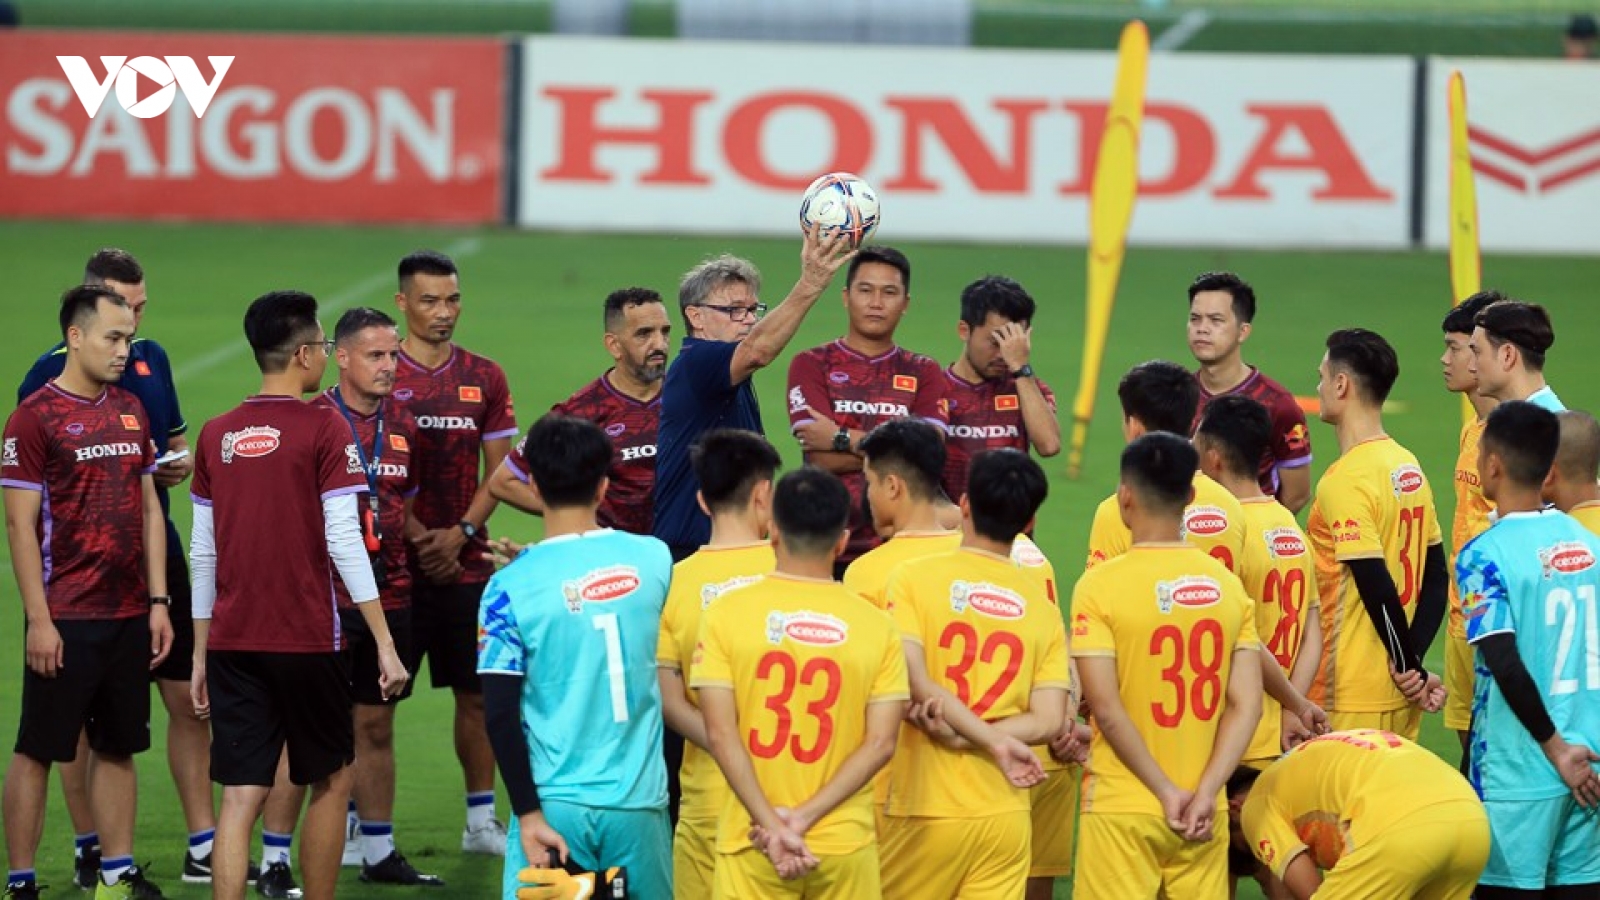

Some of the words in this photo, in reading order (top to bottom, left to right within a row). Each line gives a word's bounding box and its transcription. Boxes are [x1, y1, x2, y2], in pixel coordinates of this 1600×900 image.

[540, 84, 1396, 203] HONDA
[416, 414, 478, 430] ONDA
[834, 399, 909, 416] HONDA
[75, 443, 142, 462] HONDA
[236, 439, 275, 451] ACECOOK
[1398, 507, 1424, 606] 37
[585, 578, 636, 597] ACECOOK
[971, 594, 1022, 615] ACECOOK
[1175, 589, 1219, 601] ACECOOK
[788, 624, 841, 641] ACECOOK
[1262, 568, 1306, 669] 28
[1545, 585, 1600, 696] 21
[592, 613, 629, 722] 1
[938, 620, 1024, 718] 32
[1149, 618, 1224, 728] 38
[748, 650, 842, 764] 33
